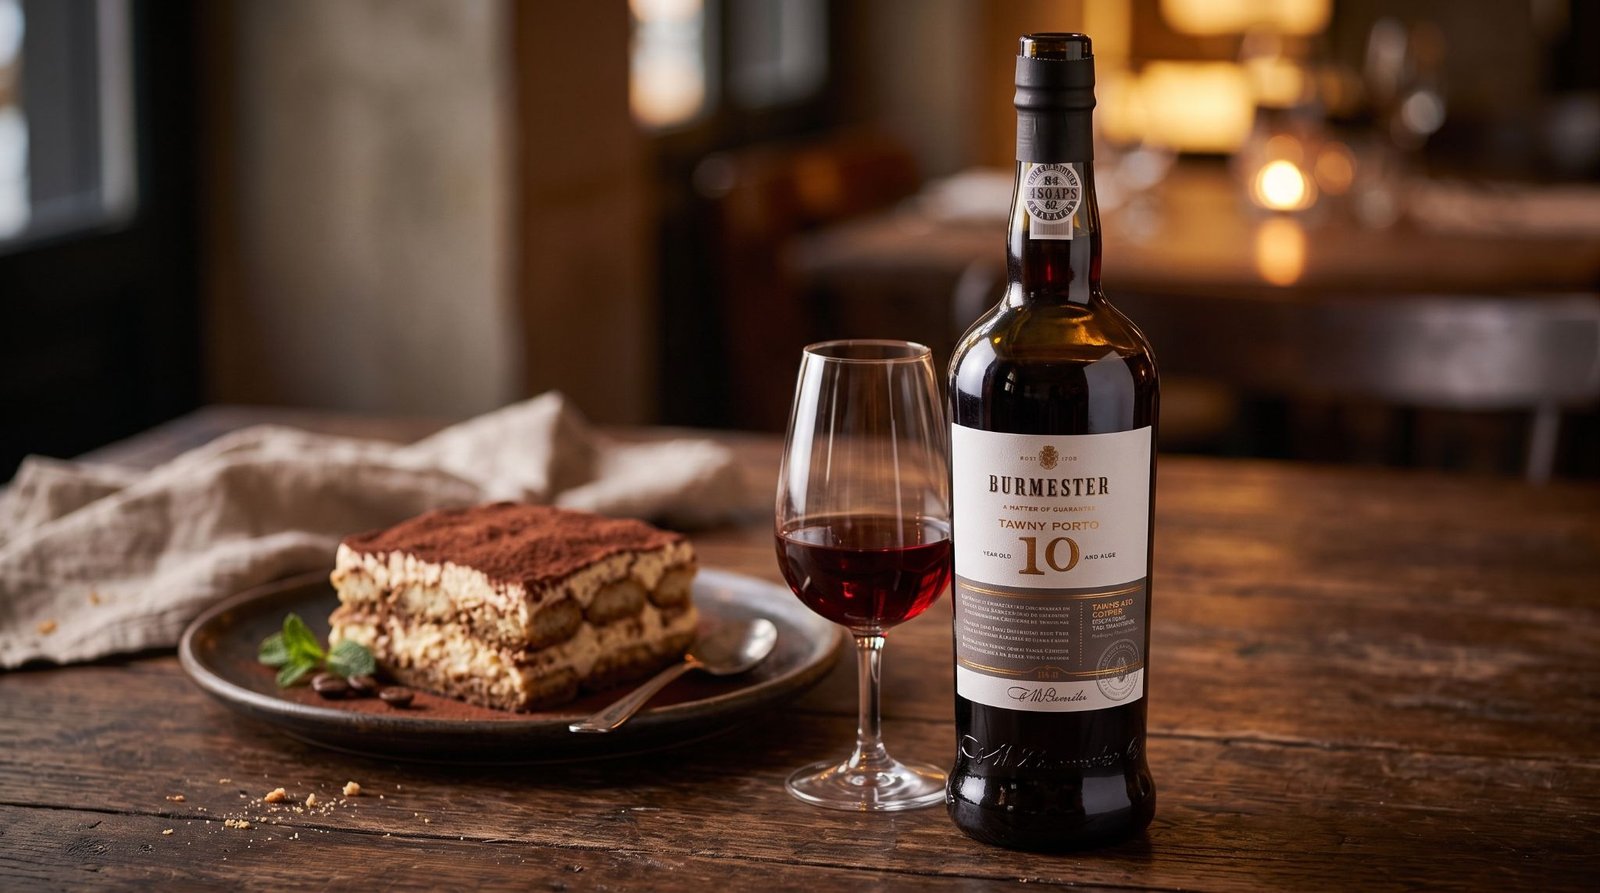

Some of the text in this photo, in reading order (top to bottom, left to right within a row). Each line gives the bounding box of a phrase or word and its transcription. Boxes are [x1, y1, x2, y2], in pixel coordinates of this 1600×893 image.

[989, 475, 1109, 497] BURMESTER
[998, 518, 1099, 531] TAWNY PORTO
[982, 550, 998, 558] YEAR
[998, 552, 1012, 560] OLD
[1018, 536, 1080, 575] 10
